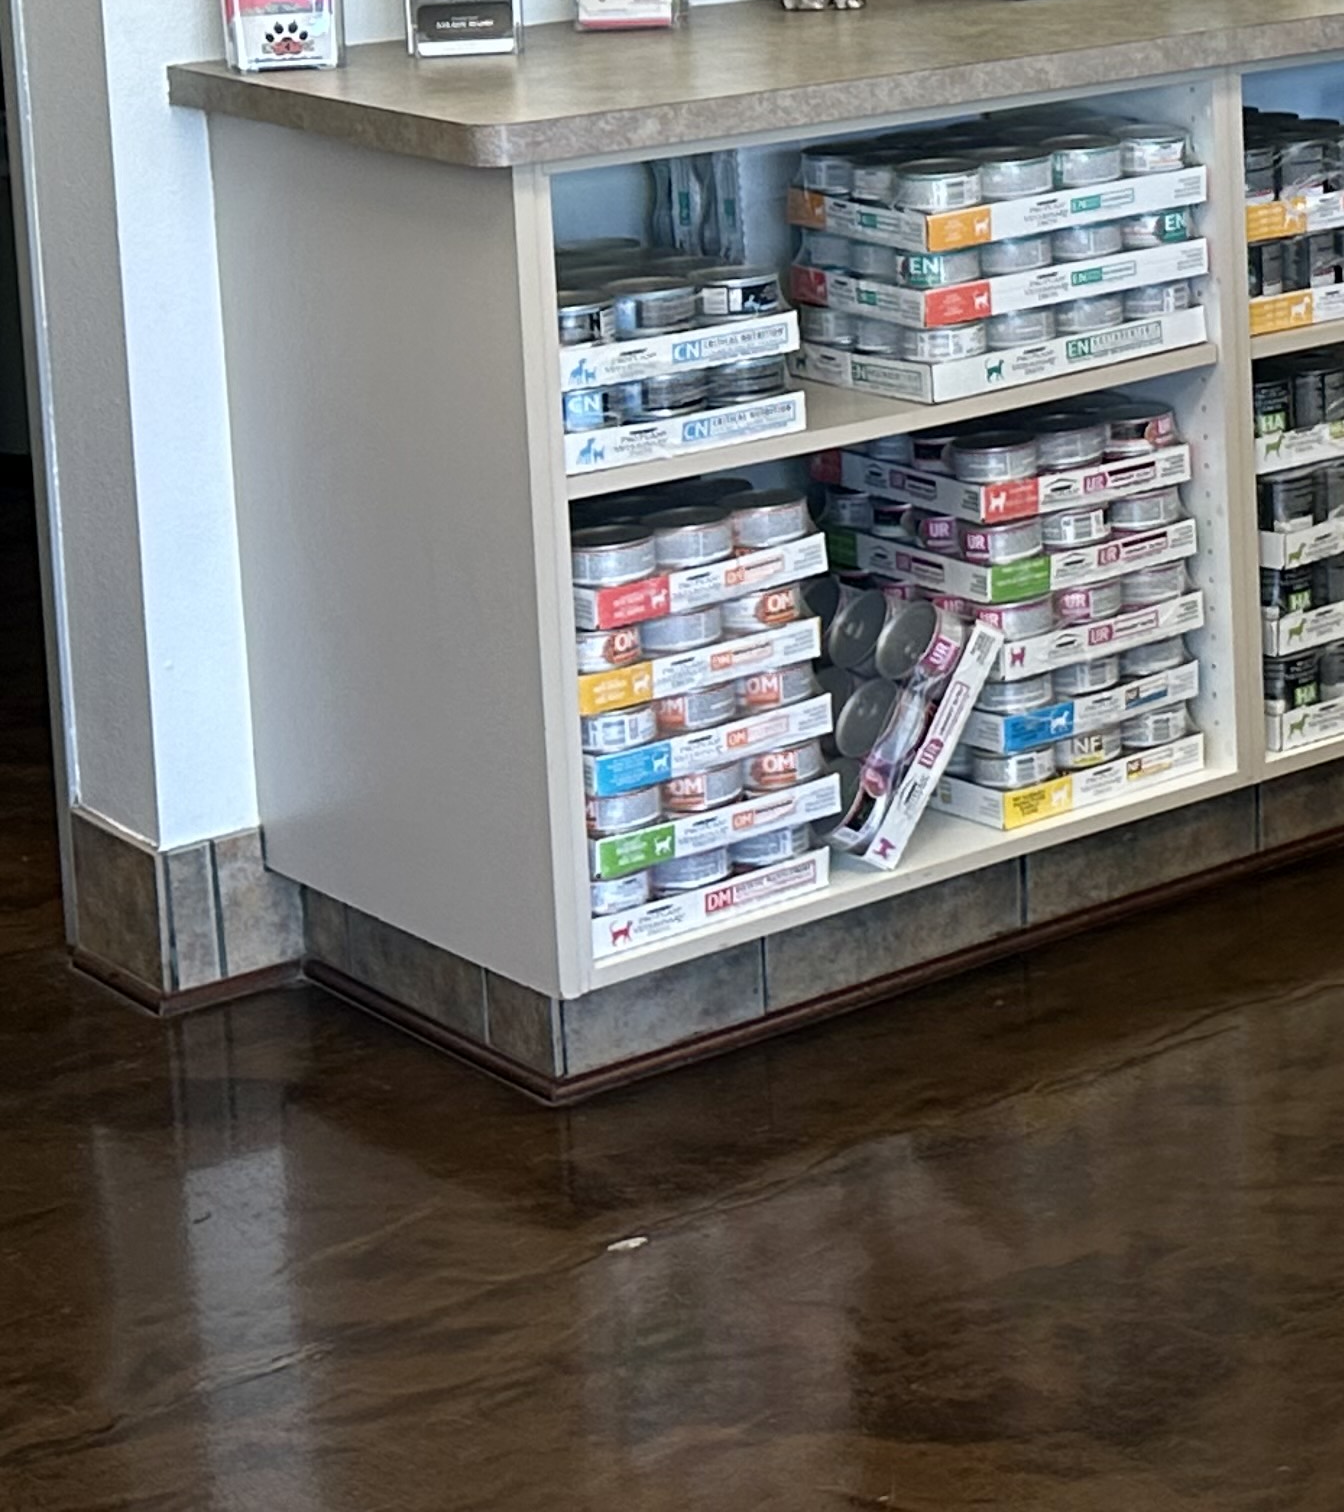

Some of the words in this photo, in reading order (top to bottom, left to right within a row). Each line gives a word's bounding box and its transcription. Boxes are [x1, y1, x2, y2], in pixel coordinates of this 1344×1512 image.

[909, 258, 939, 275] EN
[674, 339, 701, 361] CN
[1068, 341, 1090, 359] EN
[567, 393, 599, 413] CN
[683, 420, 710, 441] CN
[1263, 415, 1284, 430] HA
[928, 521, 950, 538] UR
[967, 533, 986, 550] UR
[767, 590, 793, 611] OM
[1064, 592, 1087, 609] UR
[614, 630, 638, 652] OM
[1090, 626, 1112, 645] UR
[929, 643, 950, 664] UR
[746, 674, 779, 695] OM
[920, 742, 941, 767] UR
[1073, 736, 1102, 755] NF
[762, 751, 795, 772] OM
[674, 777, 704, 796] OM
[706, 891, 733, 912] DM
